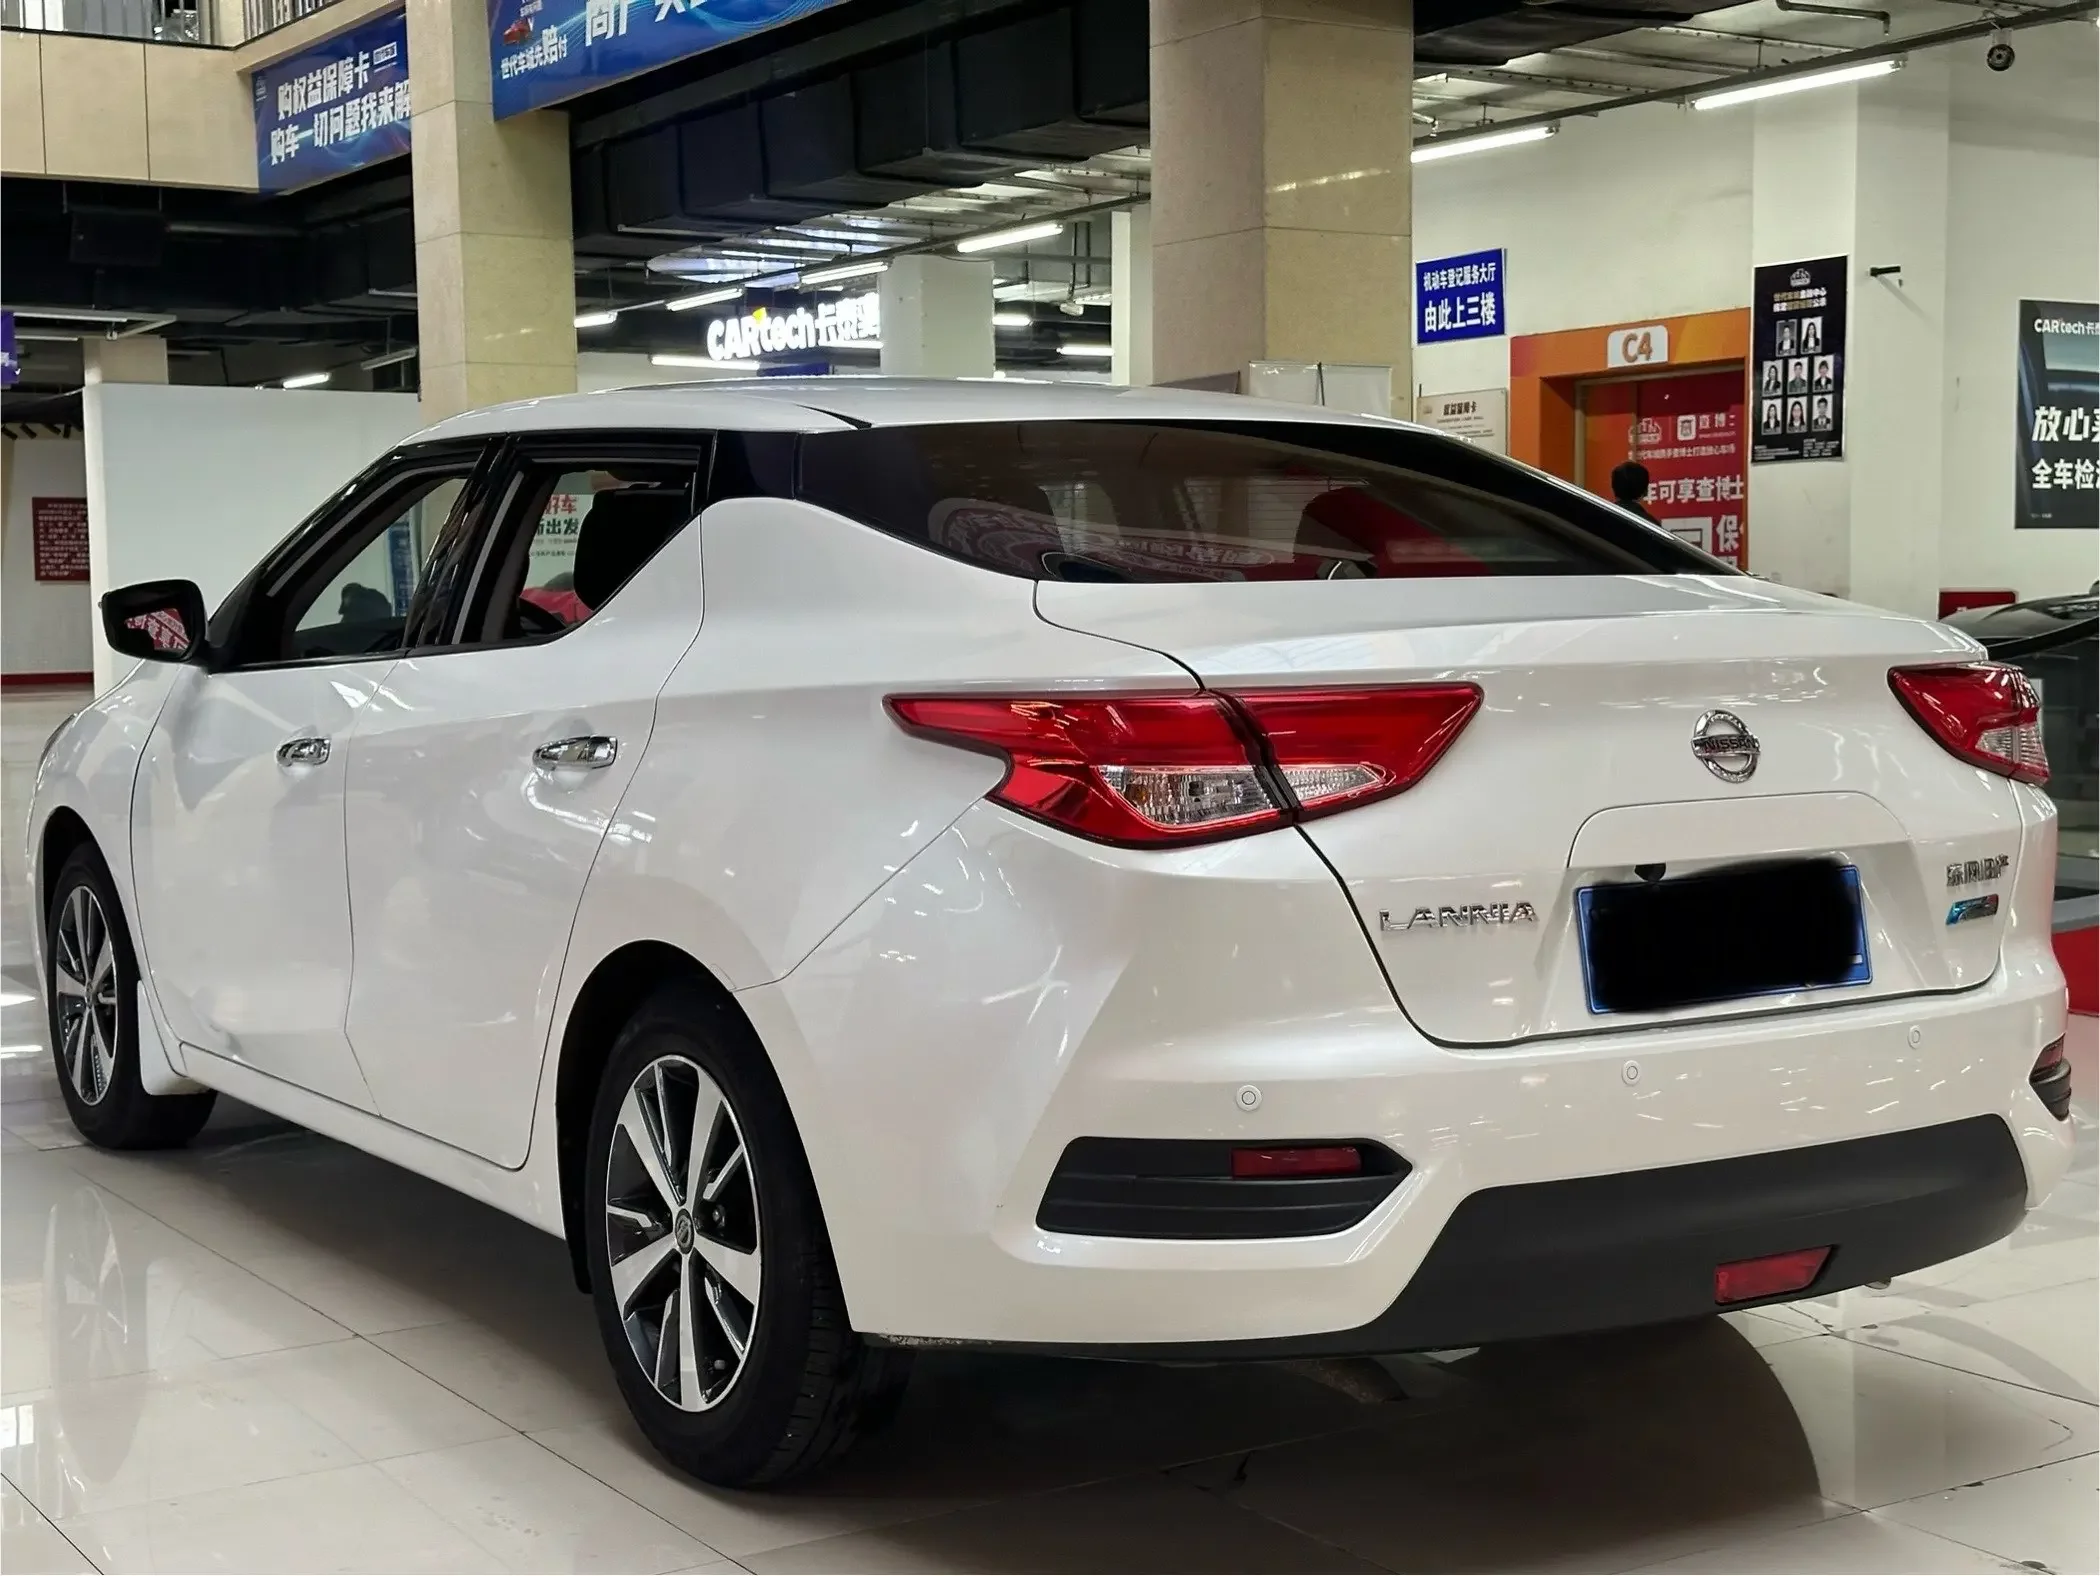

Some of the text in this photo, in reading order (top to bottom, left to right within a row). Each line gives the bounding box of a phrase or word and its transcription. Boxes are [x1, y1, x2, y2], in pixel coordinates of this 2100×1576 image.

[501, 25, 567, 79] 世代车城先赔付
[278, 51, 370, 121] 购权益保障卡
[271, 79, 411, 166] 购车一切问题我来解
[1423, 262, 1496, 291] 机动车登记服务大厅
[1425, 291, 1496, 333] 由此上三楼
[1622, 331, 1653, 363] C4
[2031, 458, 2099, 489] 全车检
[1704, 735, 1756, 753] NISSAN
[1380, 901, 1539, 931] LANNIA
